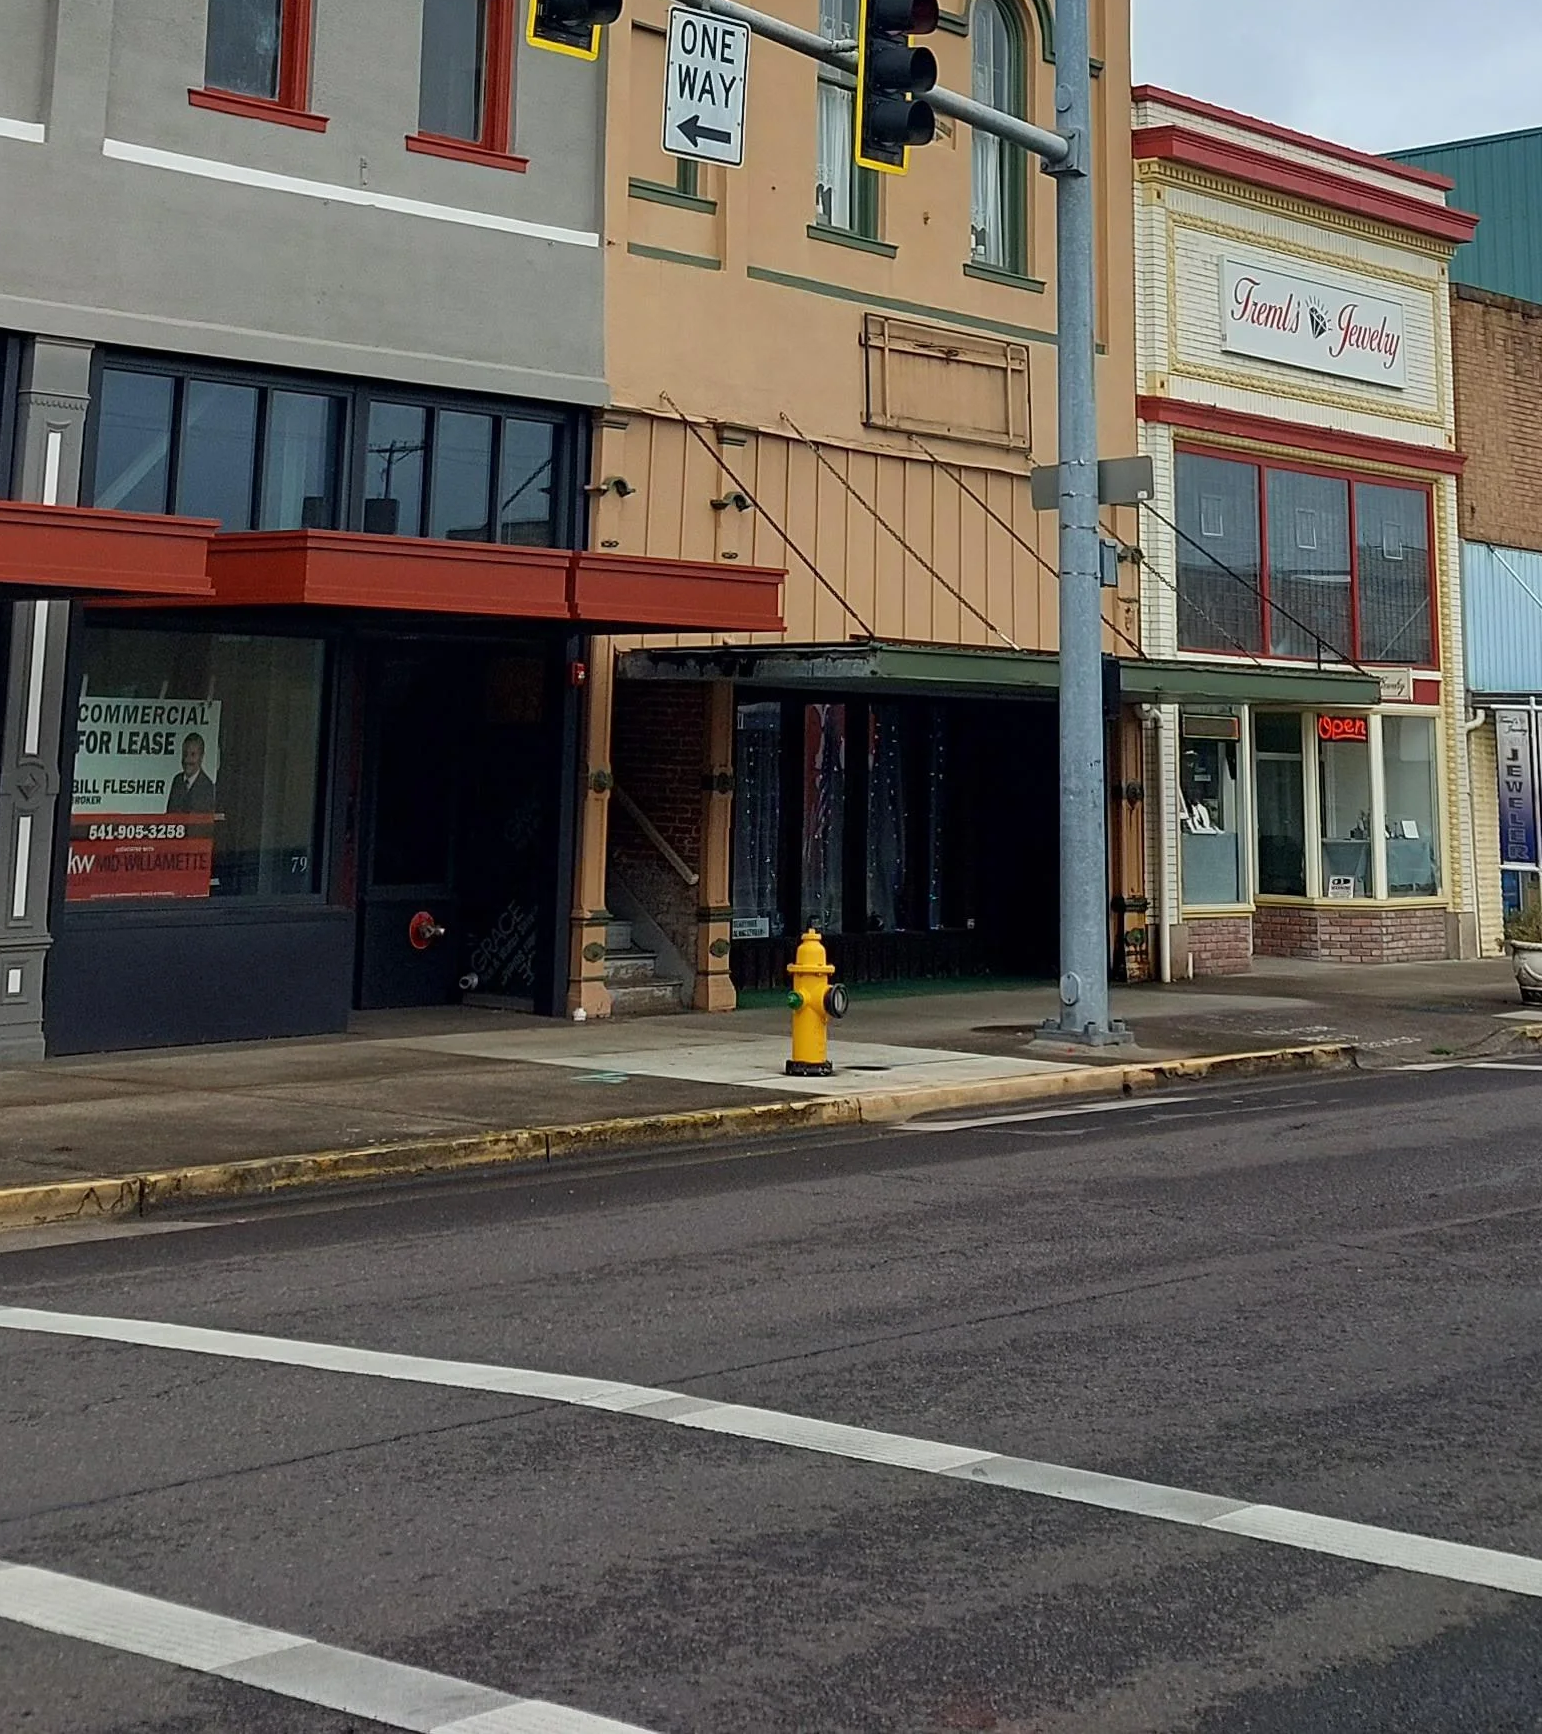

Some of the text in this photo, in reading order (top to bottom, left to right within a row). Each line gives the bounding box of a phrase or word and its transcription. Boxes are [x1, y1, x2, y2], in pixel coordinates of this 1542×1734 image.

[680, 19, 735, 65] ONE
[678, 63, 736, 109] WAY
[1328, 303, 1401, 370] Jewelry
[78, 703, 210, 725] COMMERCIAL
[1318, 713, 1367, 740] Open
[76, 730, 177, 755] FOR LEASE
[71, 779, 166, 795] BILL FLESHER
[67, 846, 96, 875] kw
